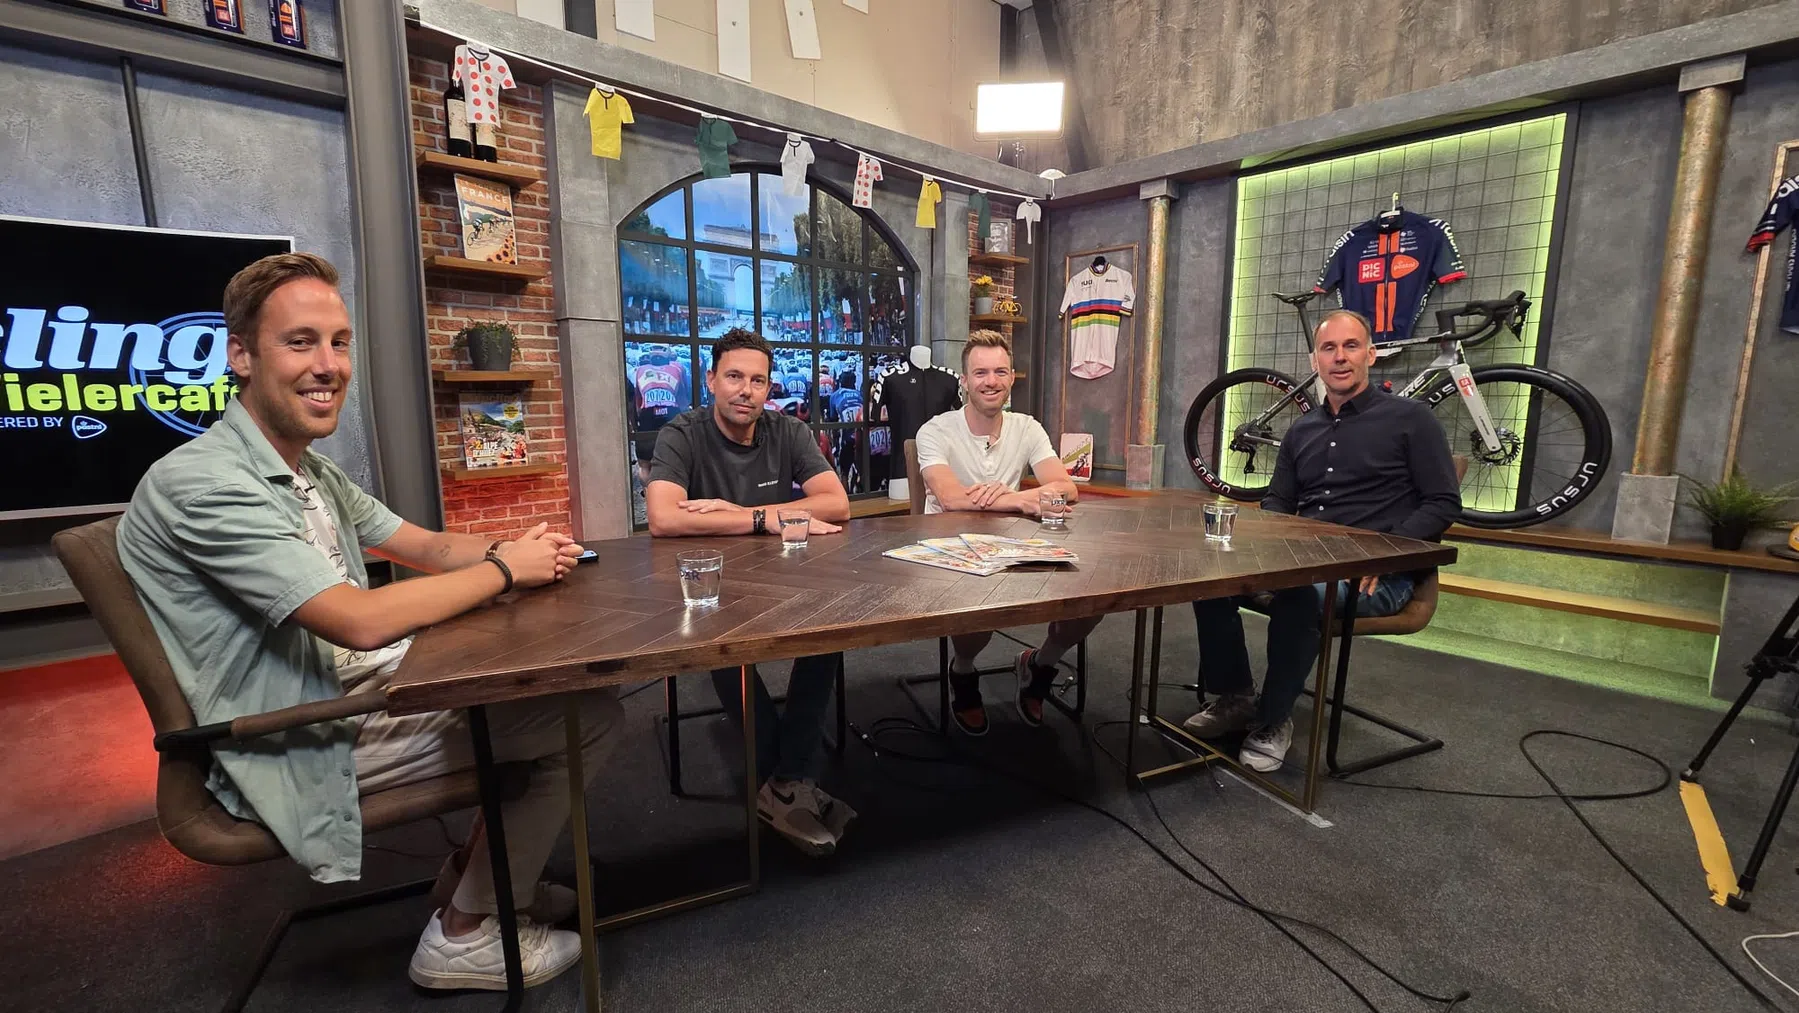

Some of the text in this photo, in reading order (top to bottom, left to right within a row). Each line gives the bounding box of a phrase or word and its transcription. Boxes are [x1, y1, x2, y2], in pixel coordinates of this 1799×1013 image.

[461, 187, 508, 204] FRANCE
[0, 305, 230, 385] ling
[0, 373, 240, 411] ielercaf
[43, 416, 63, 428] BY
